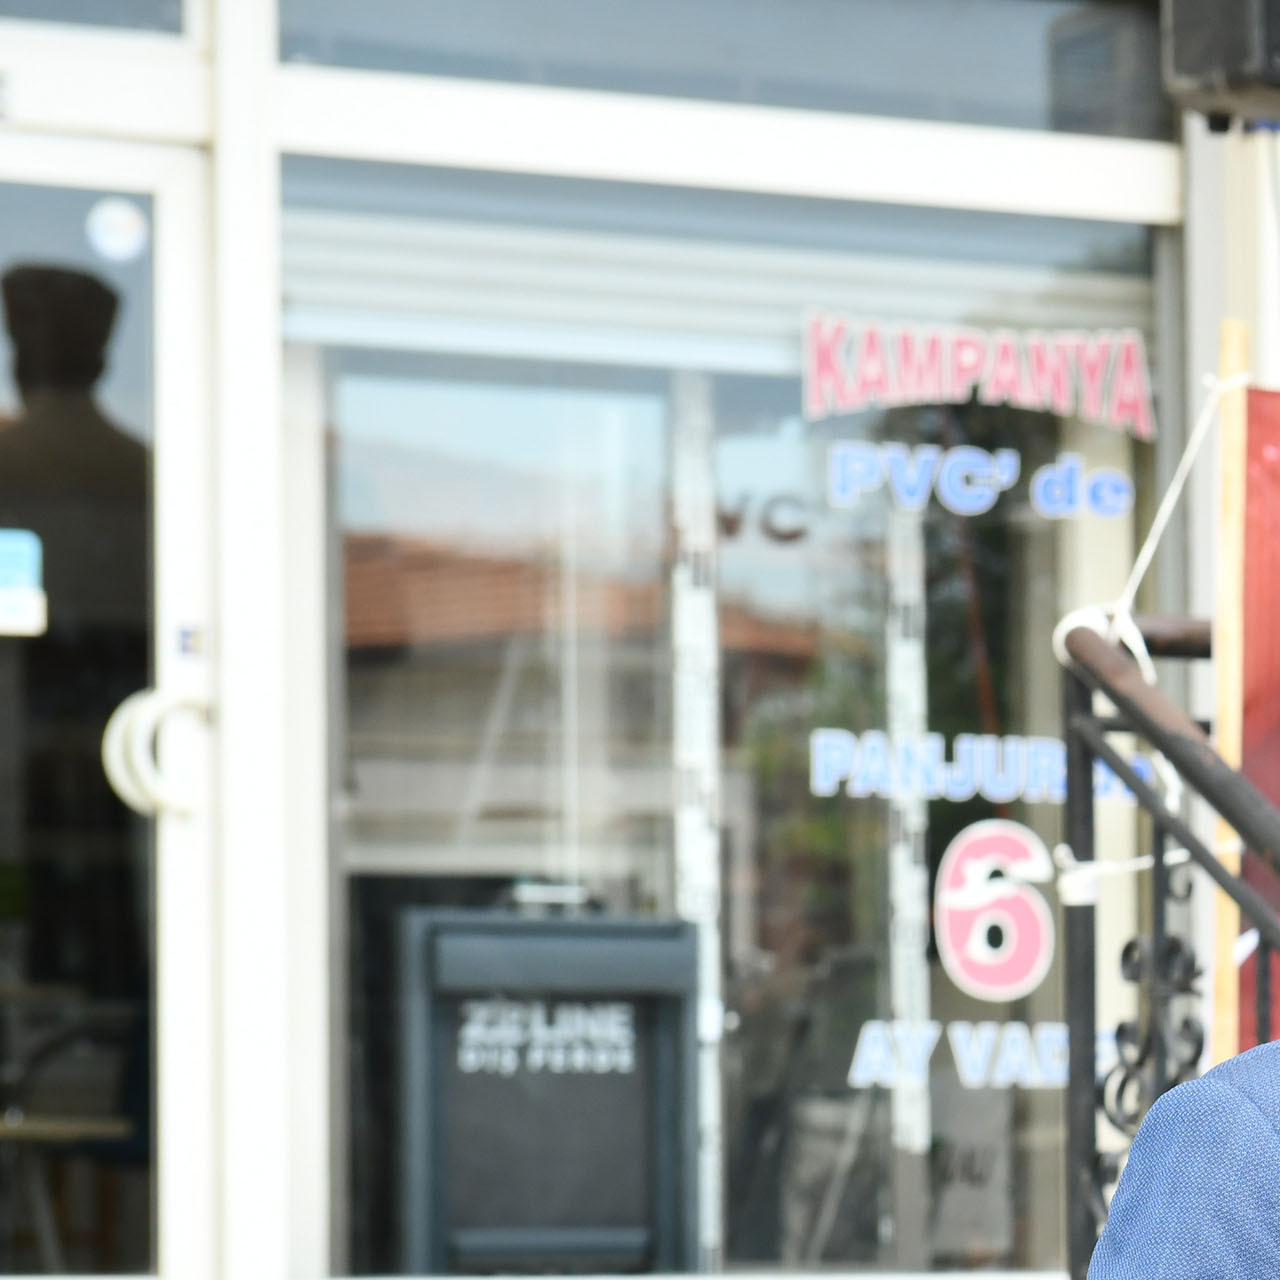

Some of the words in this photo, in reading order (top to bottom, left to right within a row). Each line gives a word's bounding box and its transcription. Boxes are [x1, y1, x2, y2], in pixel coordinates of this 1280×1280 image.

[805, 306, 1158, 442] KAMPANYA
[1030, 450, 1136, 521] de
[935, 817, 1055, 1004] 6
[846, 1018, 943, 1089] AY
